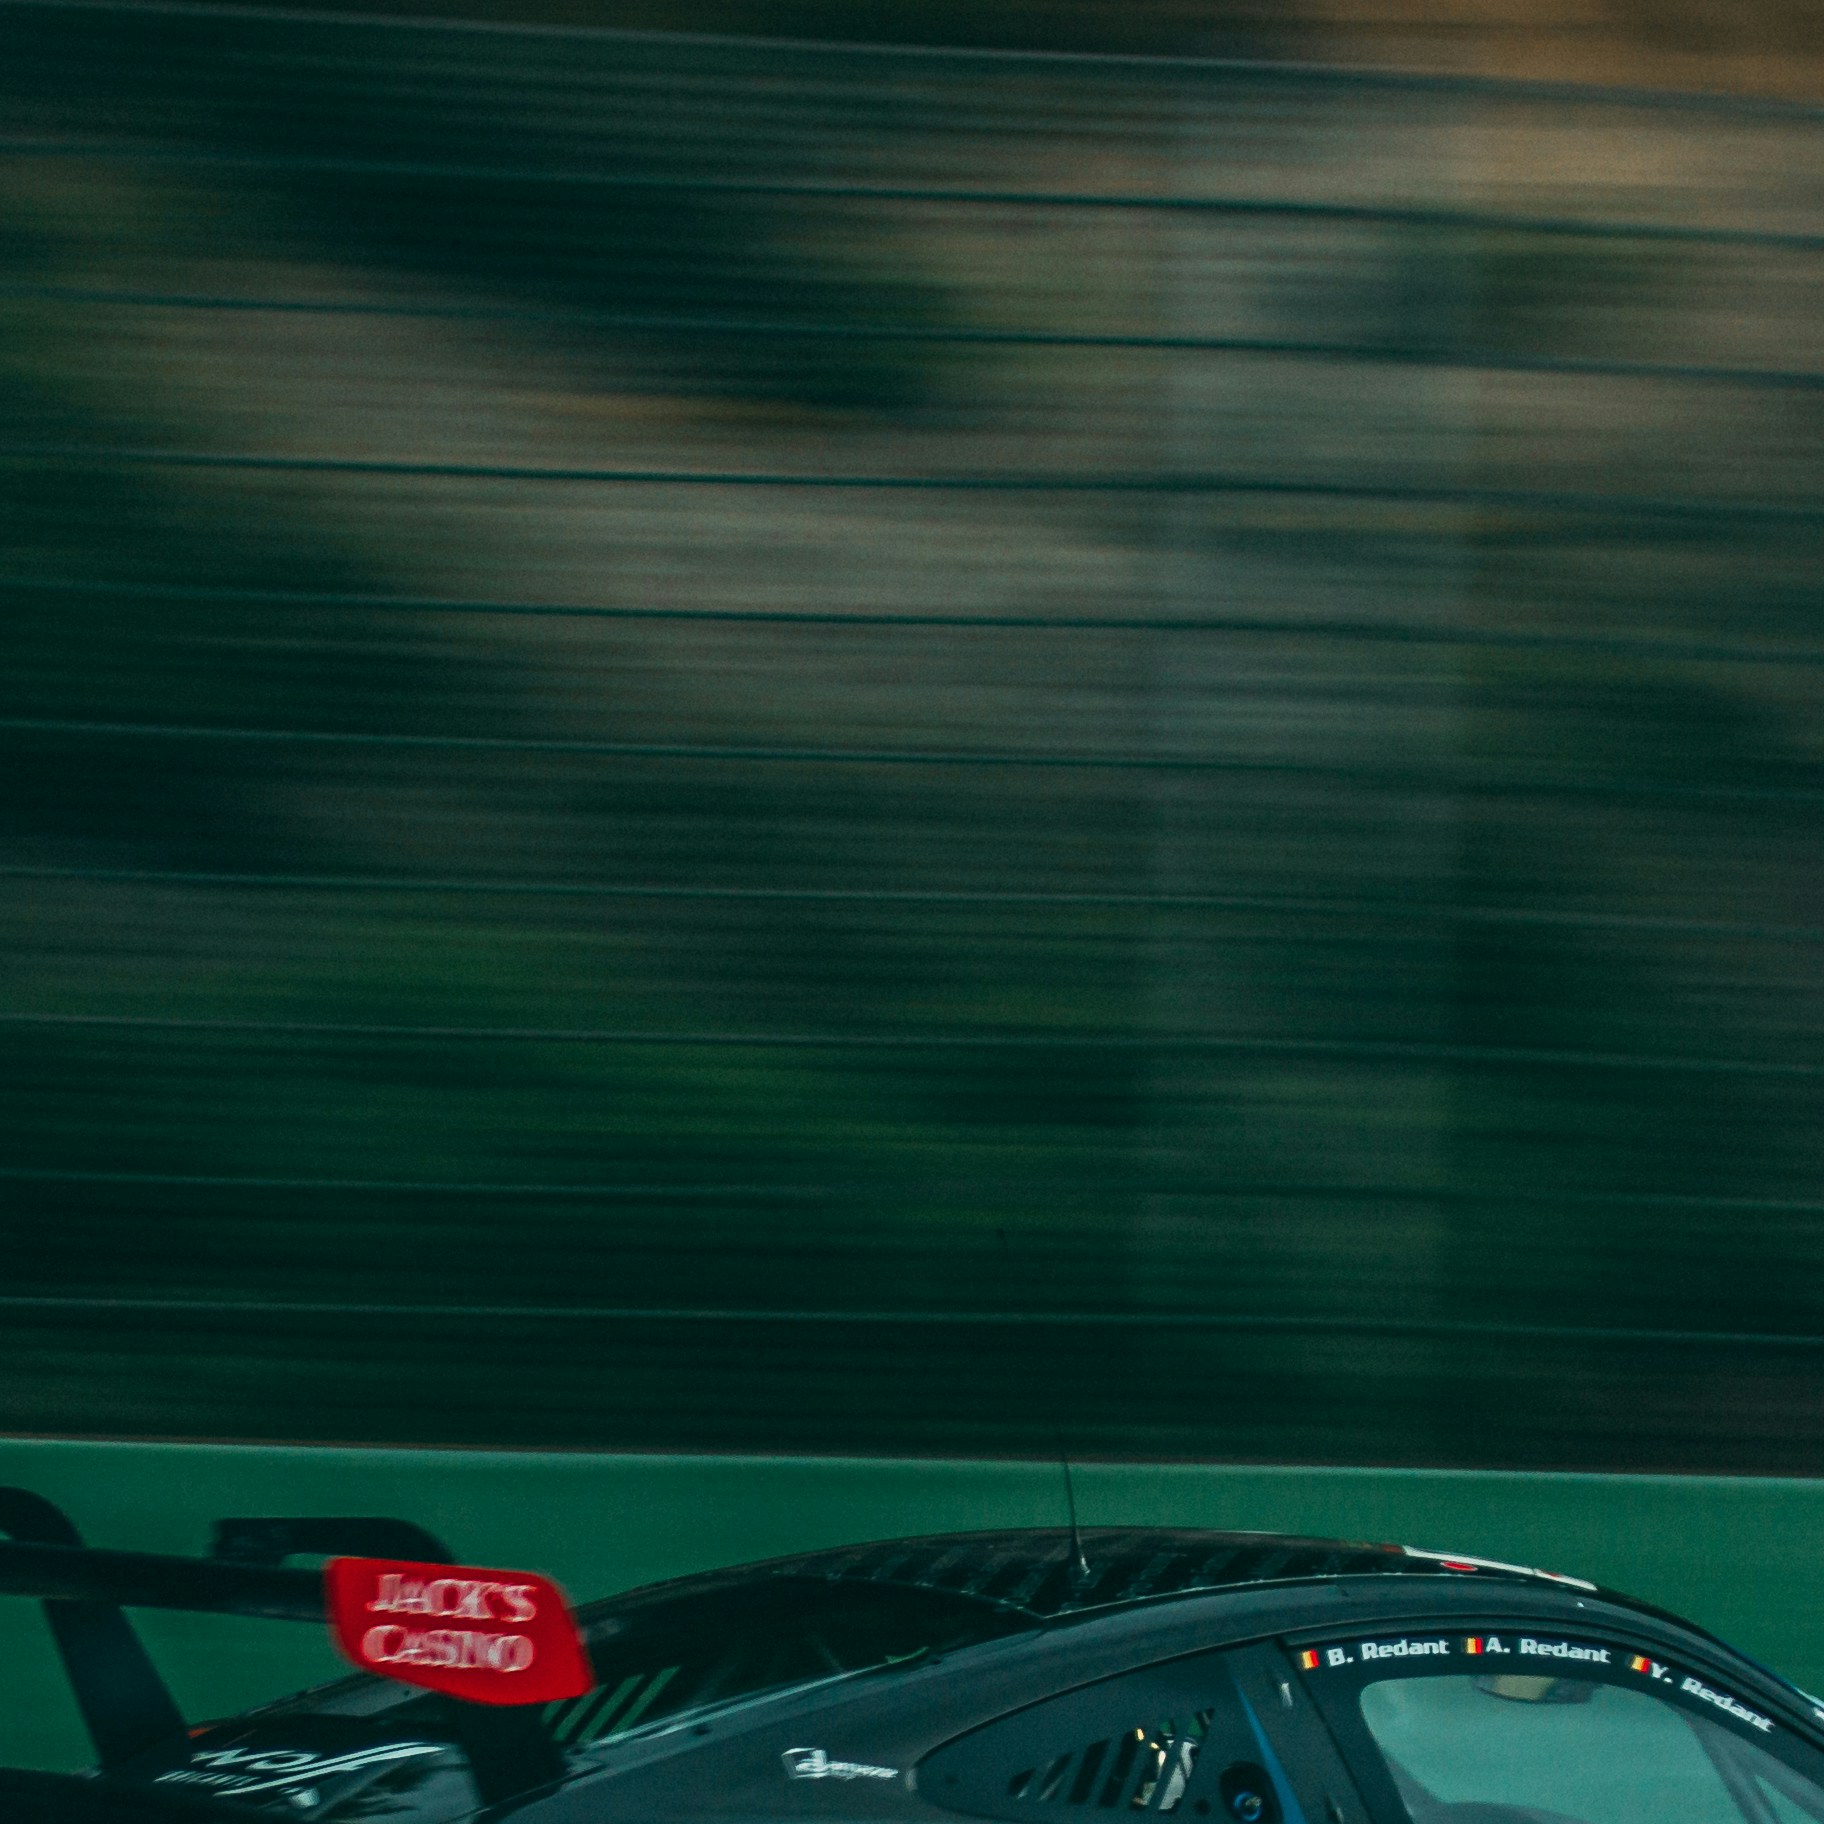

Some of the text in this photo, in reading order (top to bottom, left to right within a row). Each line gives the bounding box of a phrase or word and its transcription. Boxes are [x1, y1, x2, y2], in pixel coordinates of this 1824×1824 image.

[1326, 1638, 1450, 1667] B. Redant
[1486, 1636, 1612, 1664] A. Redant
[1651, 1661, 1776, 1733] Y. Redant
